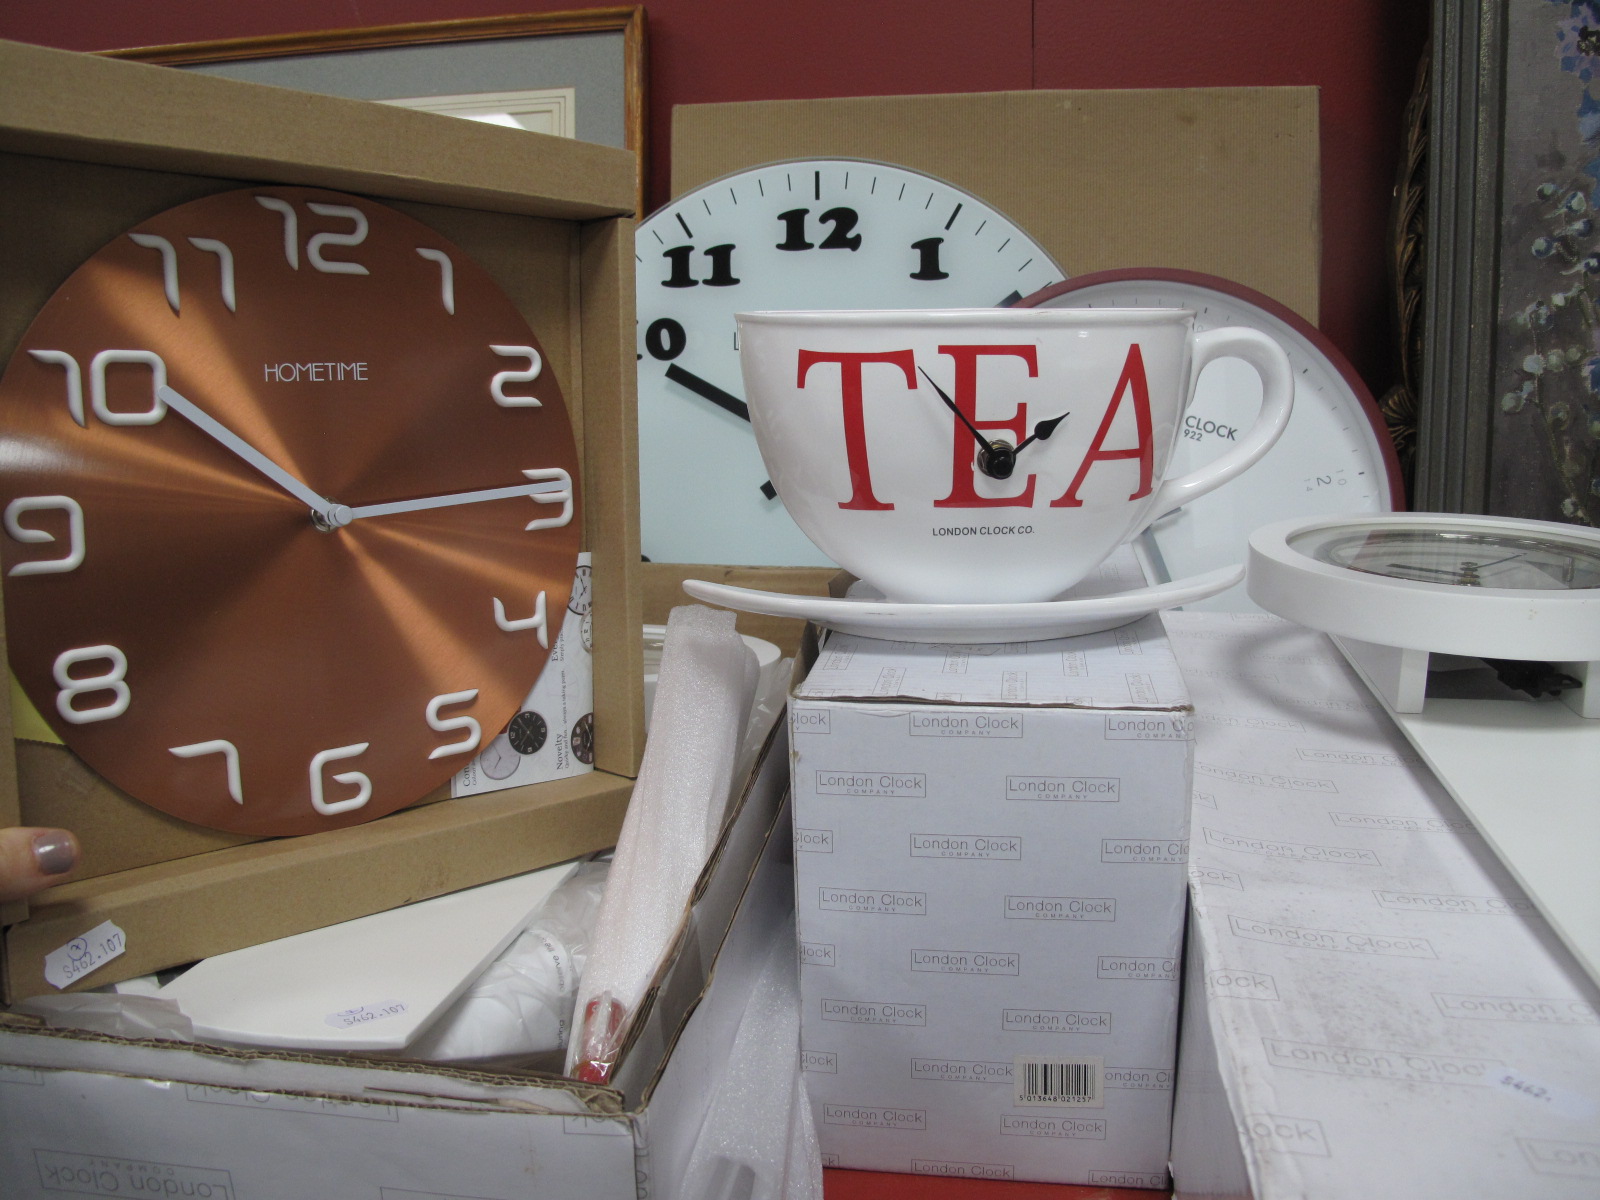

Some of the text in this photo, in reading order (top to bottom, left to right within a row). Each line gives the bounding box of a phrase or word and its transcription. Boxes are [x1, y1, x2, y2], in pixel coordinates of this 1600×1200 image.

[255, 196, 369, 275] 12
[776, 207, 862, 251] 12
[661, 244, 740, 288] 11
[910, 237, 950, 281] 1
[128, 233, 236, 312] 11
[416, 247, 454, 315] 1
[637, 318, 686, 361] 0
[265, 362, 368, 382] HOMETIME
[489, 345, 542, 407] 2
[27, 349, 167, 427] 10
[796, 343, 1155, 511] TEA
[1183, 429, 1203, 441] 922
[1185, 415, 1238, 441] CLOCK
[522, 468, 574, 530] 3
[4, 495, 85, 576] 9
[933, 526, 1035, 536] LONDON CLOCK CO.
[494, 591, 548, 649] 4
[53, 645, 131, 724] 8
[425, 689, 481, 759] 5
[913, 716, 1018, 730] London Clock
[1109, 718, 1165, 730] London
[555, 734, 564, 769] Novelty
[168, 739, 243, 804] 7
[309, 742, 372, 815] 6
[1200, 764, 1331, 789] ondon Clock
[819, 774, 922, 789] London Clock
[1010, 779, 1115, 793] London Clock
[1337, 815, 1418, 826] London
[914, 837, 1017, 851] London Clock
[1105, 843, 1160, 854] London
[1210, 831, 1373, 860] London Clock
[822, 891, 922, 907] London Clock
[1008, 899, 1112, 913] London Clock
[1380, 891, 1476, 908] London
[1236, 919, 1425, 951] London Clock
[800, 946, 831, 958] lock
[914, 953, 1016, 968] London Clock
[1101, 960, 1155, 971] London
[1205, 974, 1269, 989] lock
[825, 1002, 922, 1018] London Clock
[1440, 996, 1556, 1015] London
[1006, 1010, 1108, 1027] London Clock
[1271, 1042, 1392, 1068] London
[914, 1062, 1013, 1076] London Clock
[1105, 1071, 1150, 1082] ondon
[827, 1107, 922, 1123] London Clock
[1004, 1118, 1102, 1133] London Clock
[914, 1162, 1010, 1178] London Clock
[1091, 1173, 1143, 1185] London
[45, 1164, 229, 1200] London Clock
